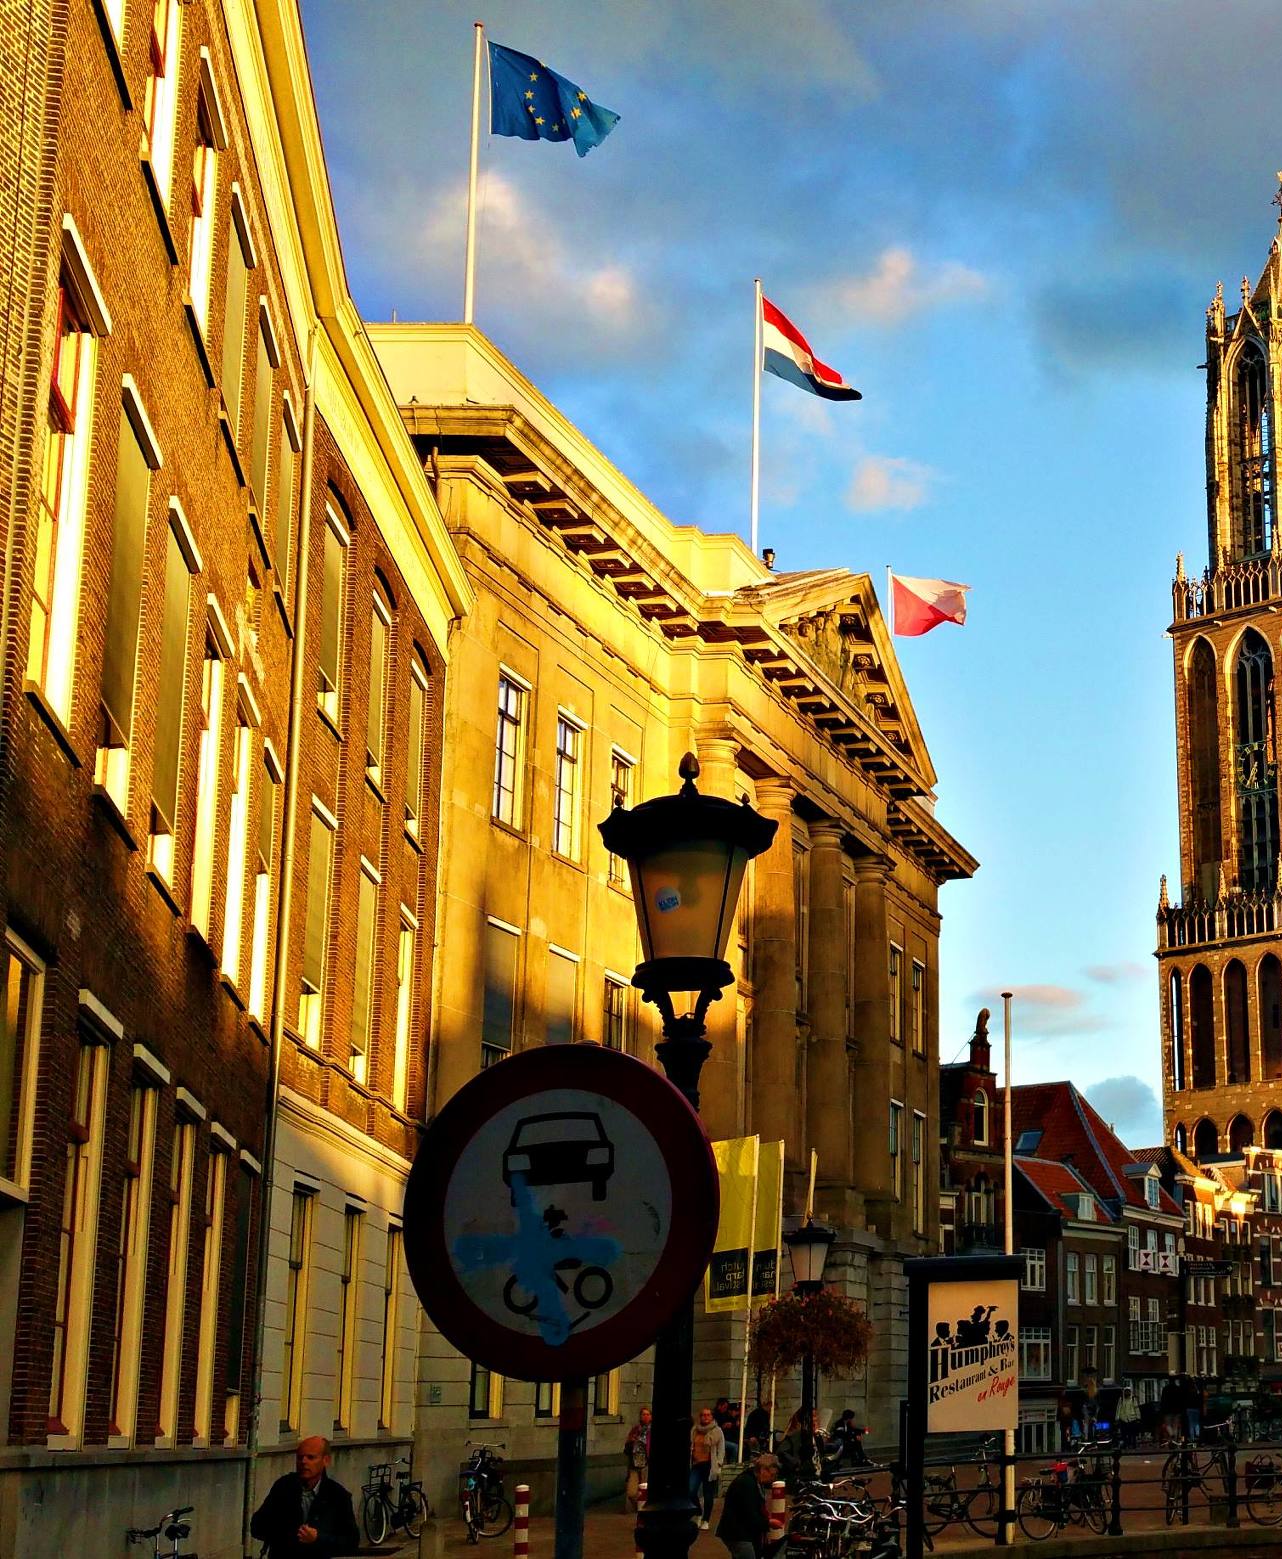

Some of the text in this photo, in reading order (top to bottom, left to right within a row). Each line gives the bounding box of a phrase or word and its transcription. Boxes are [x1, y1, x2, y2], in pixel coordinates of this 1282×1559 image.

[929, 1358, 1014, 1404] Restaurant & Bar
[989, 1376, 1015, 1397] Rouge
